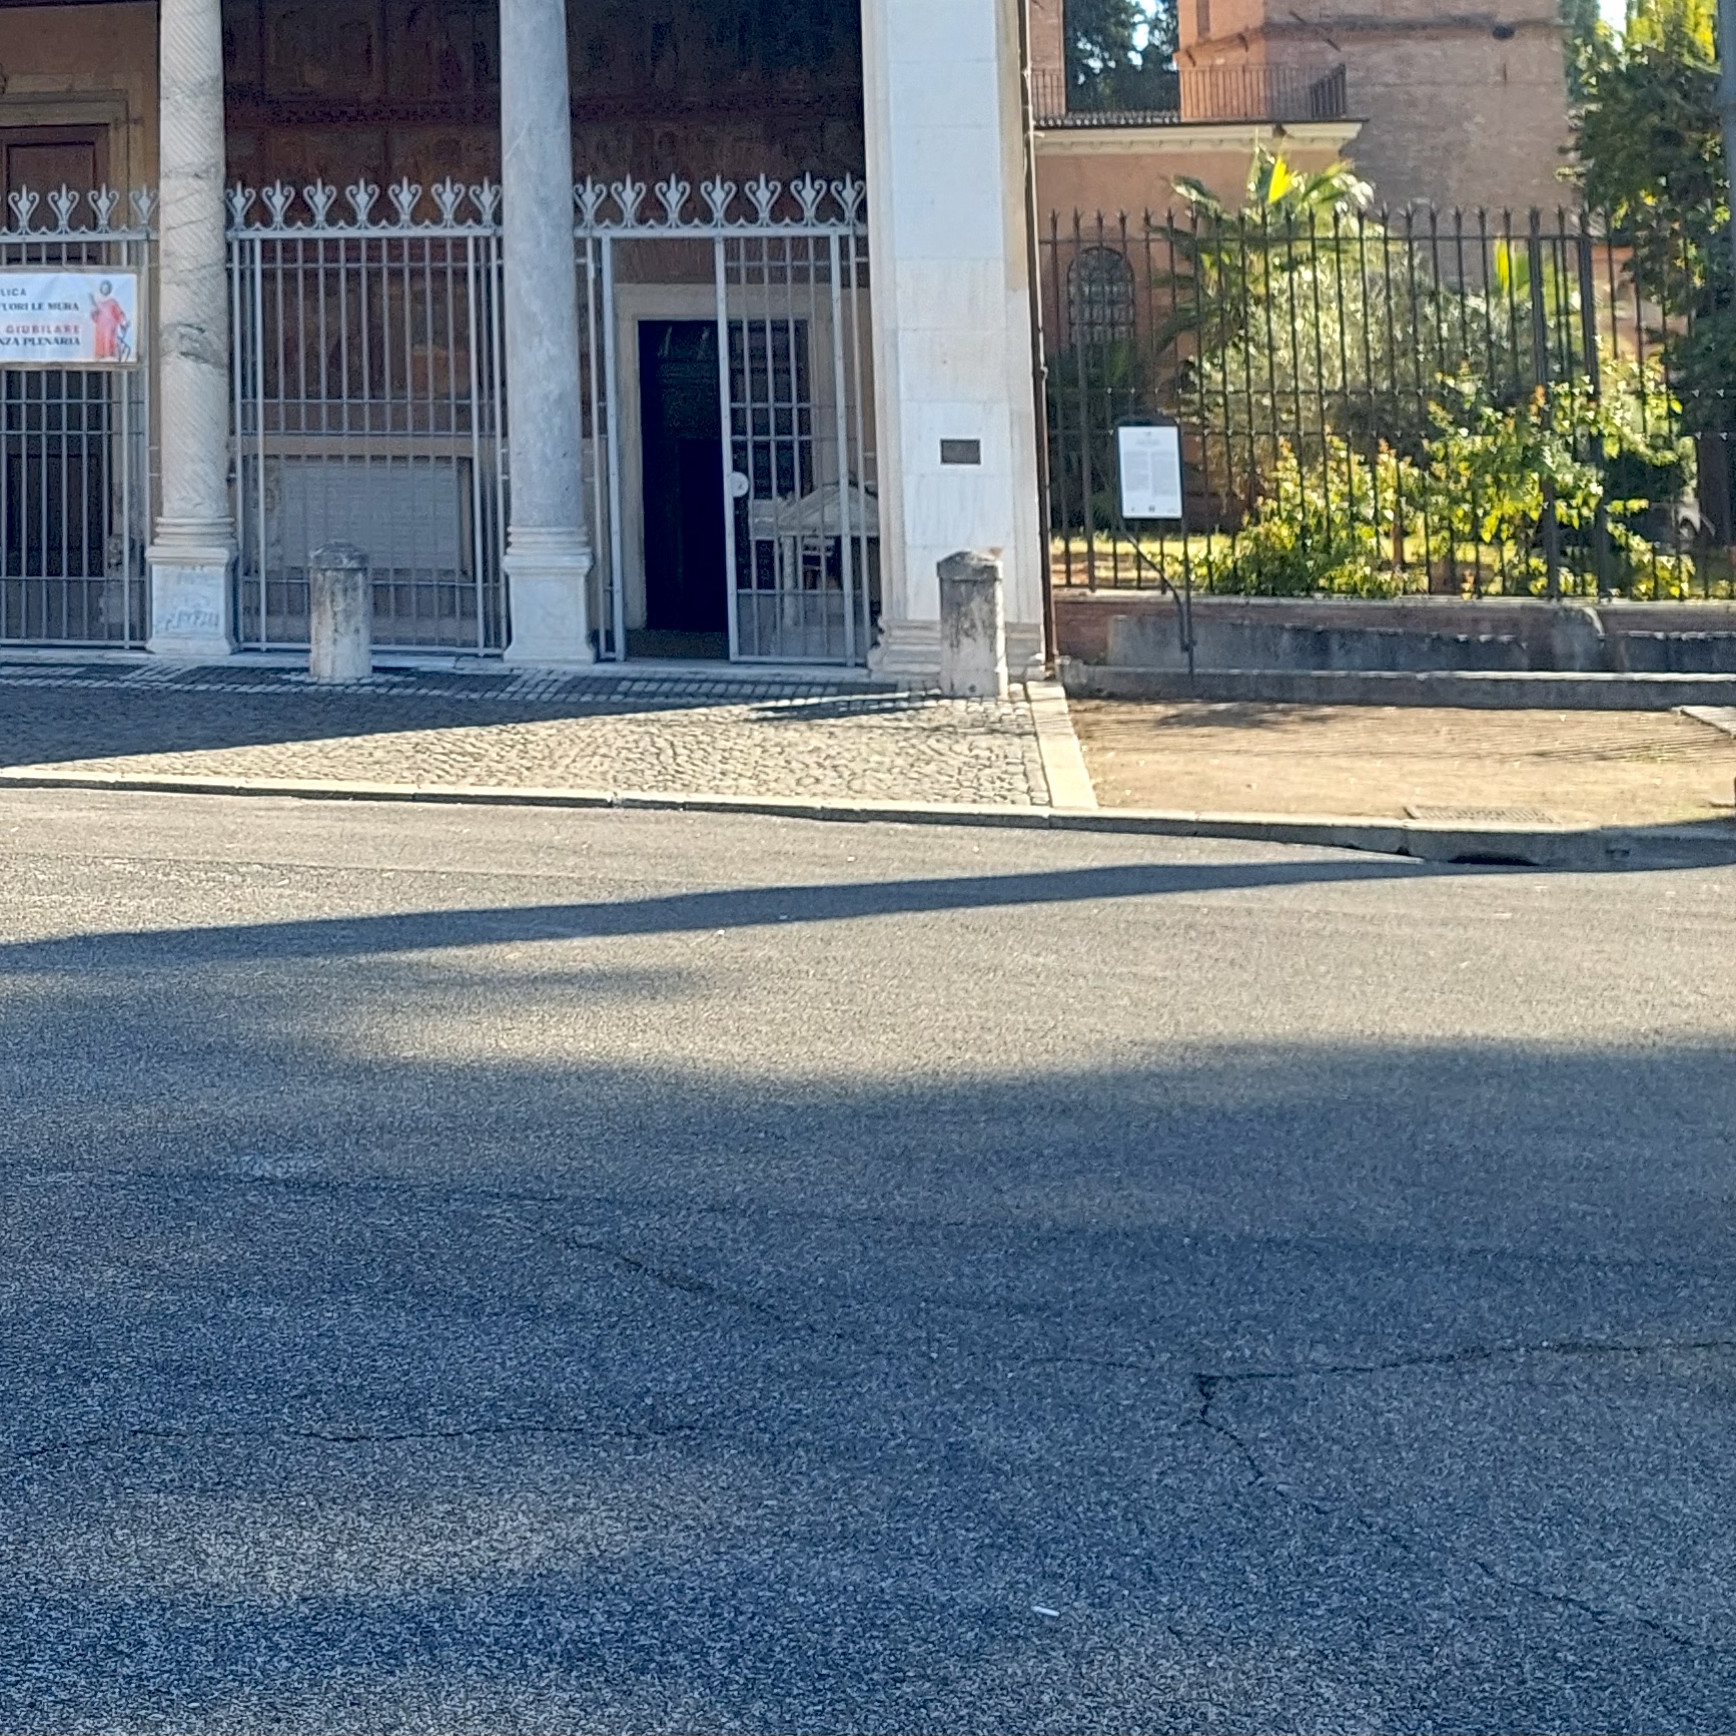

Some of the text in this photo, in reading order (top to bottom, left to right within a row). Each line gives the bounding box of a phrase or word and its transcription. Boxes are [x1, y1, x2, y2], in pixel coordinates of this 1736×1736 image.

[31, 302, 43, 311] LE
[47, 302, 80, 311] MURA
[6, 324, 80, 334] GIUBILARE
[23, 337, 81, 346] PLENARIA
